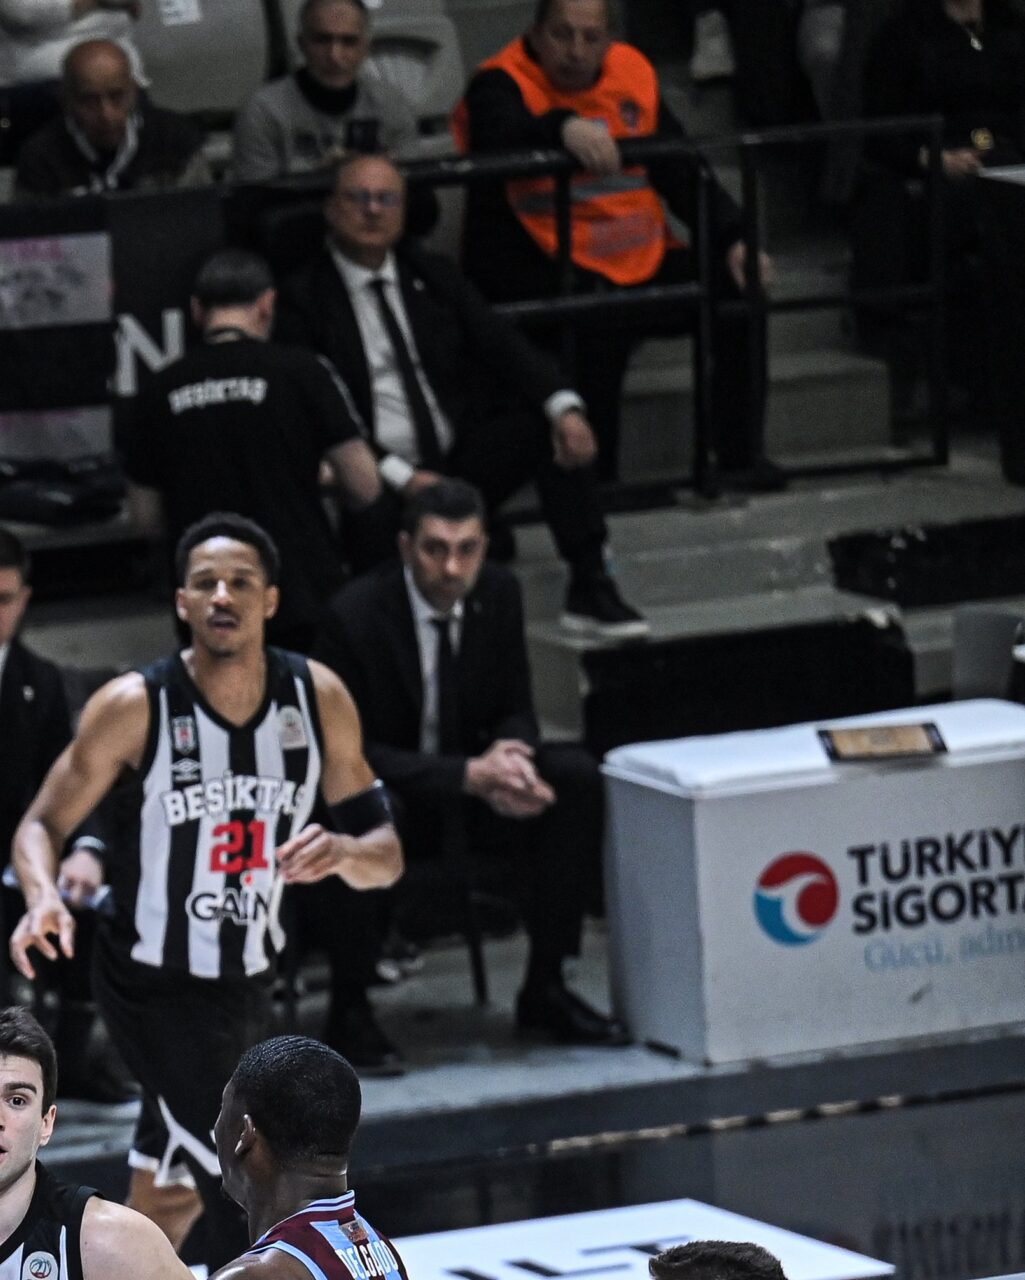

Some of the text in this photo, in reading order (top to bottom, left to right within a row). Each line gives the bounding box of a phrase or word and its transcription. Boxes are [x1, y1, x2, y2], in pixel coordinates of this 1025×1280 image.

[209, 820, 269, 873] 21
[847, 824, 1025, 887] TÜRKİY
[851, 871, 1025, 936] SİGORT
[335, 1240, 399, 1280] DELGADO
